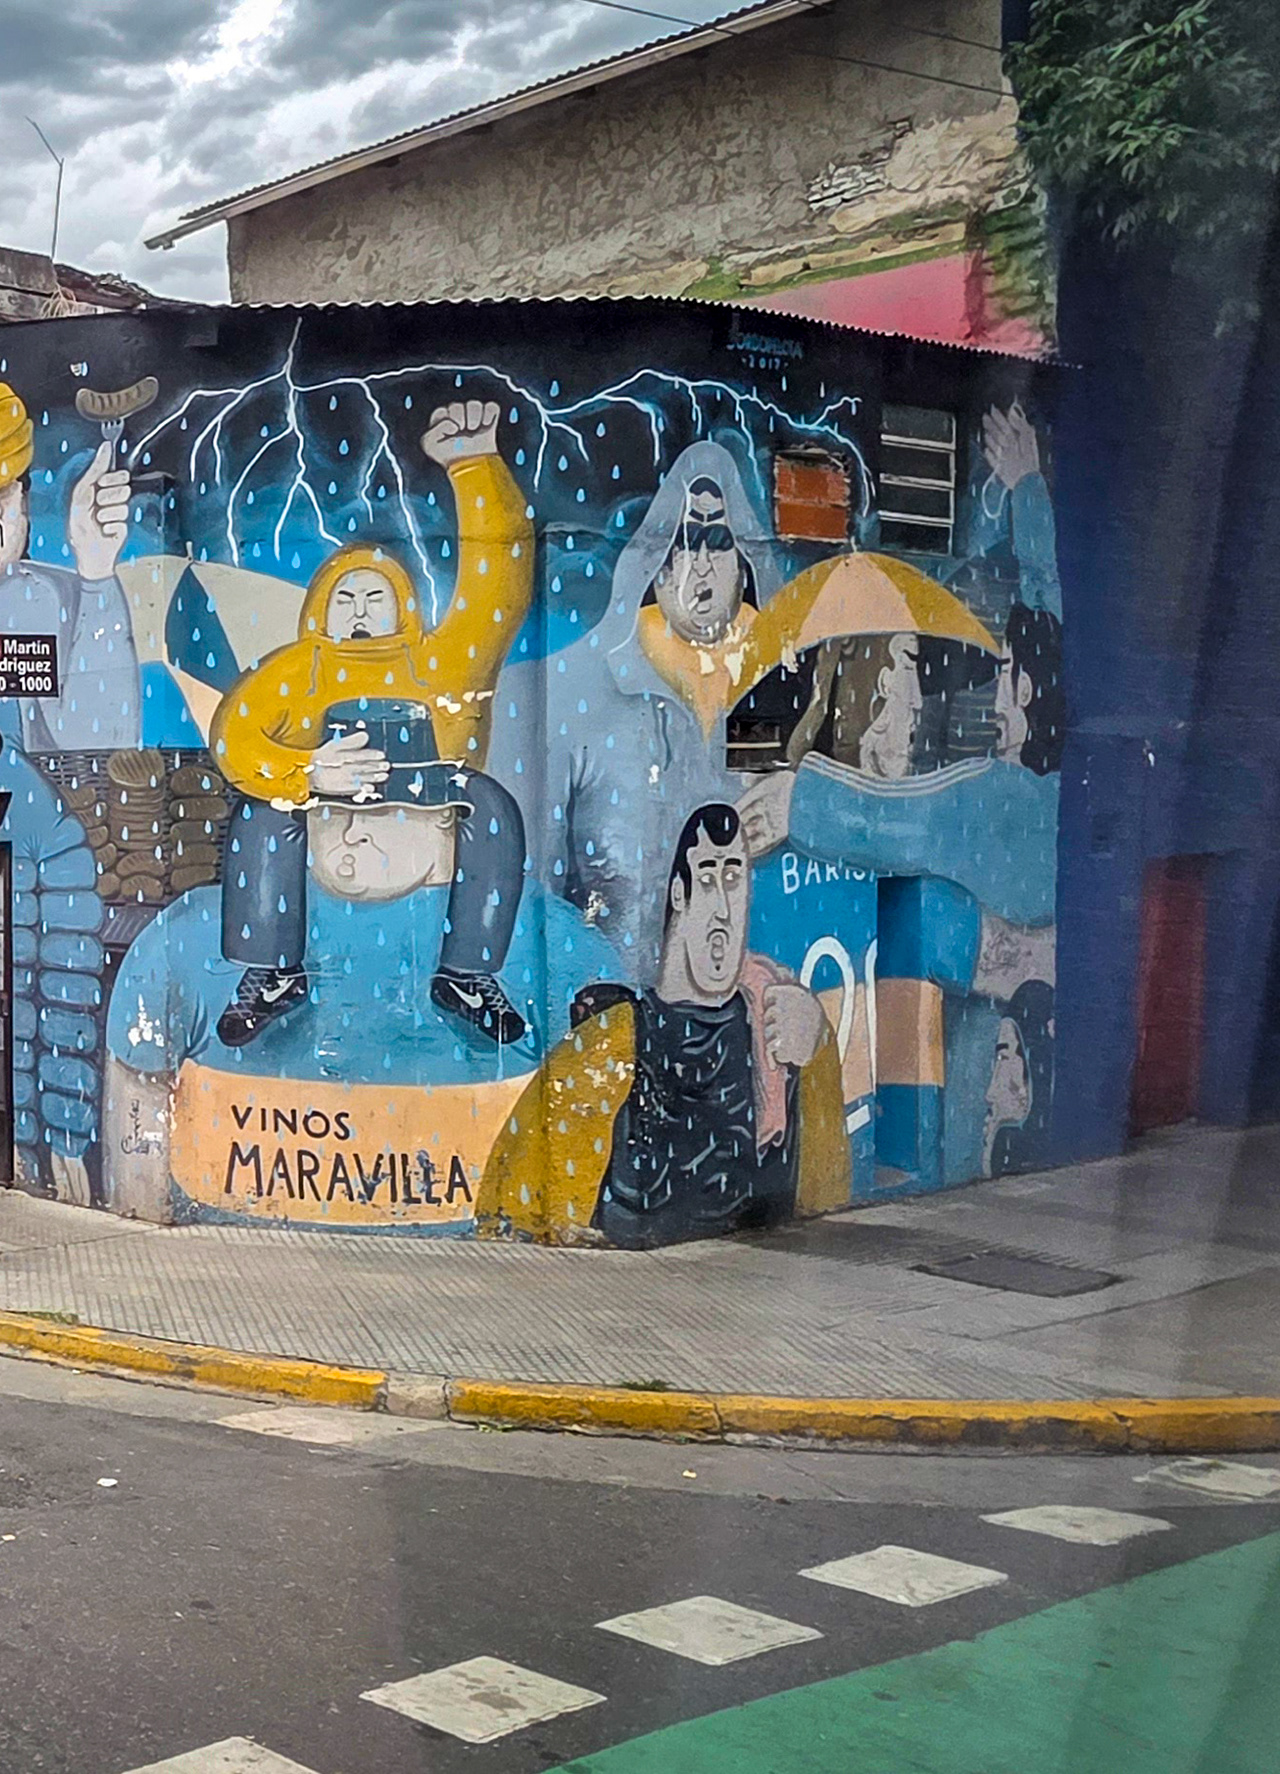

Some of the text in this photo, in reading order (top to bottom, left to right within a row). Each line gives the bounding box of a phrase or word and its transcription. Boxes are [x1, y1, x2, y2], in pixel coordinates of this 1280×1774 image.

[19, 676, 53, 692] 1000
[230, 1104, 351, 1141] VINOS
[224, 1141, 474, 1207] MARAVILLA
